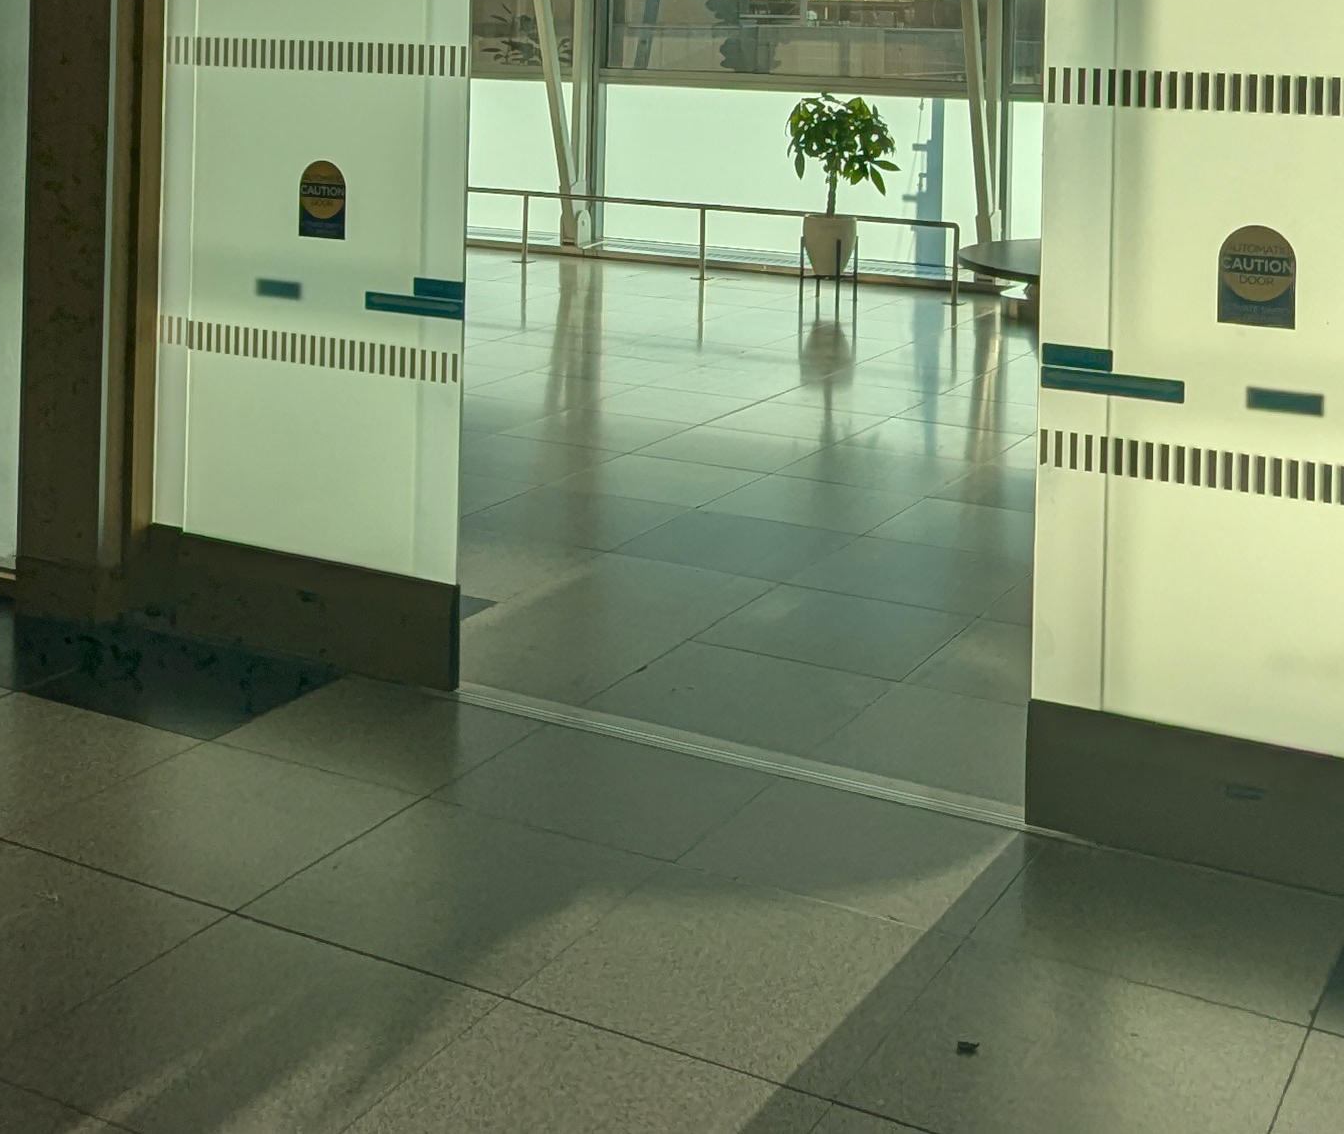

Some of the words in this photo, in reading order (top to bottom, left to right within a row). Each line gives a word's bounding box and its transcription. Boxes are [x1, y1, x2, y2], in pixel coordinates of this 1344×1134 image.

[301, 184, 344, 197] CAUTION
[1222, 256, 1293, 275] CAUTION
[1238, 275, 1275, 286] DOOR
